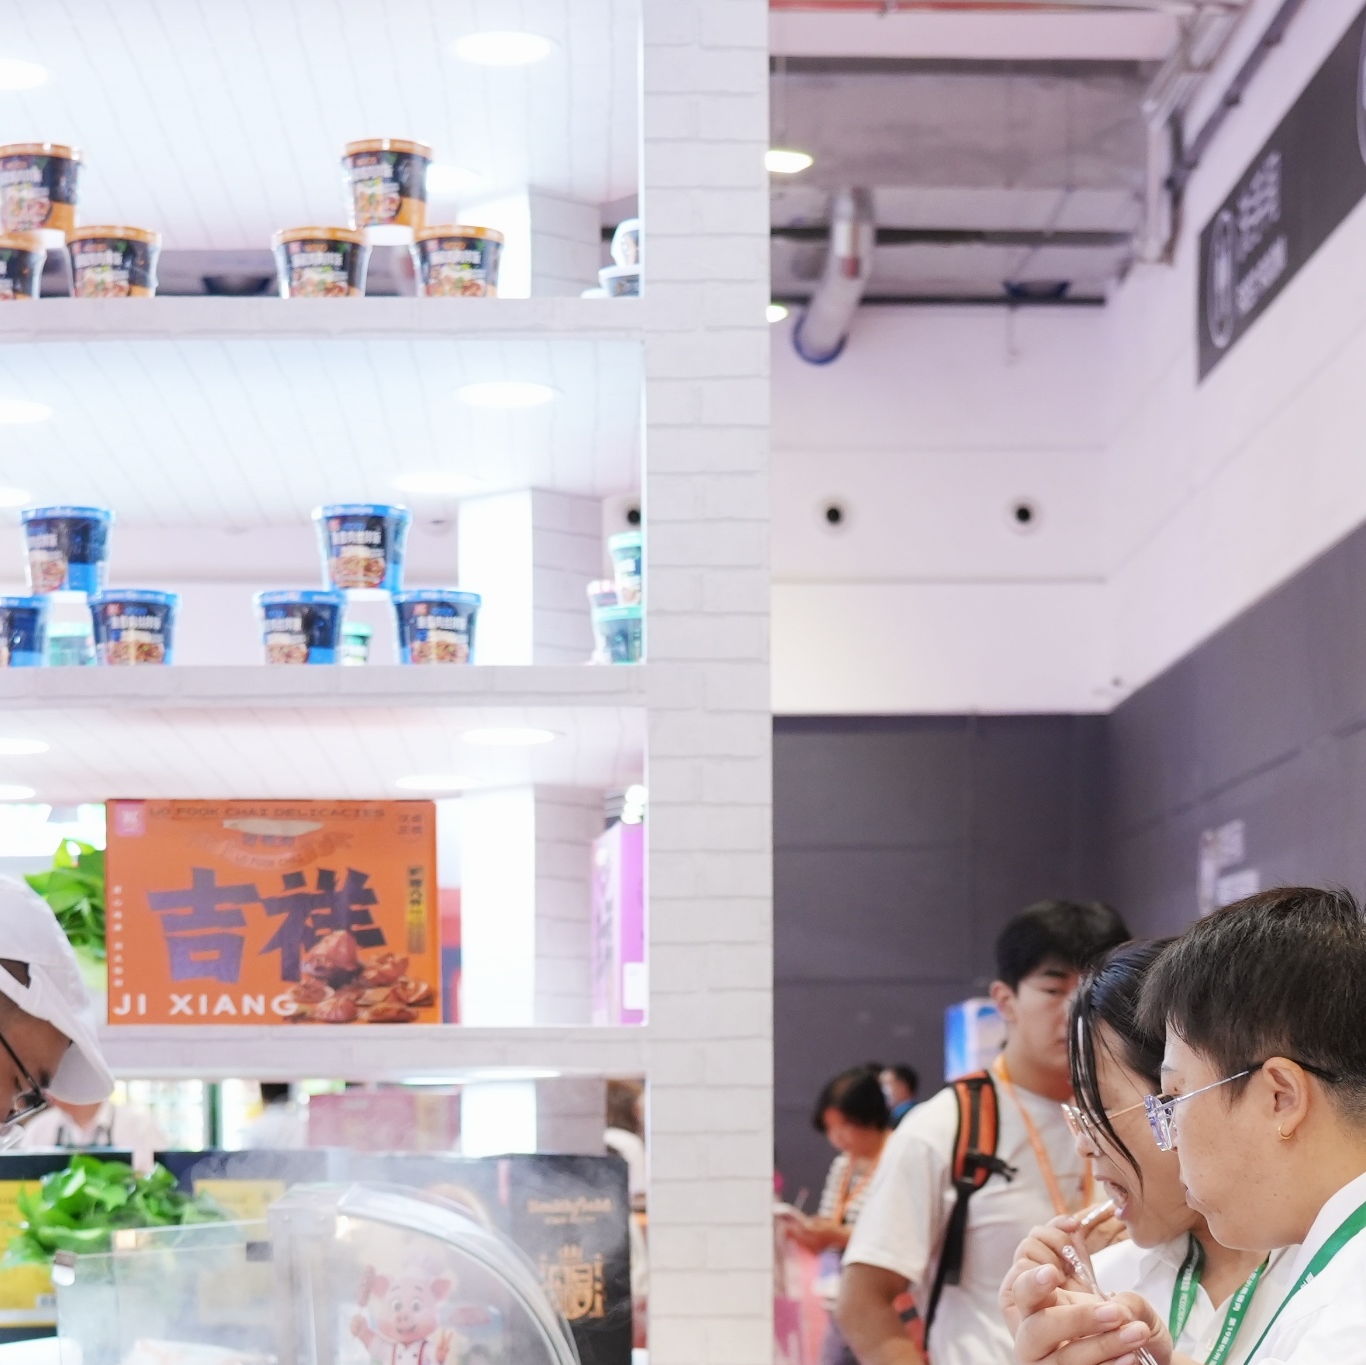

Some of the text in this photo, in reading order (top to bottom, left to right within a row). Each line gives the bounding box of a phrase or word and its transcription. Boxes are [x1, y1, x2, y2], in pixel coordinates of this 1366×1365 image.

[146, 867, 386, 983] 吉祥
[113, 993, 299, 1016] JI XIANG
